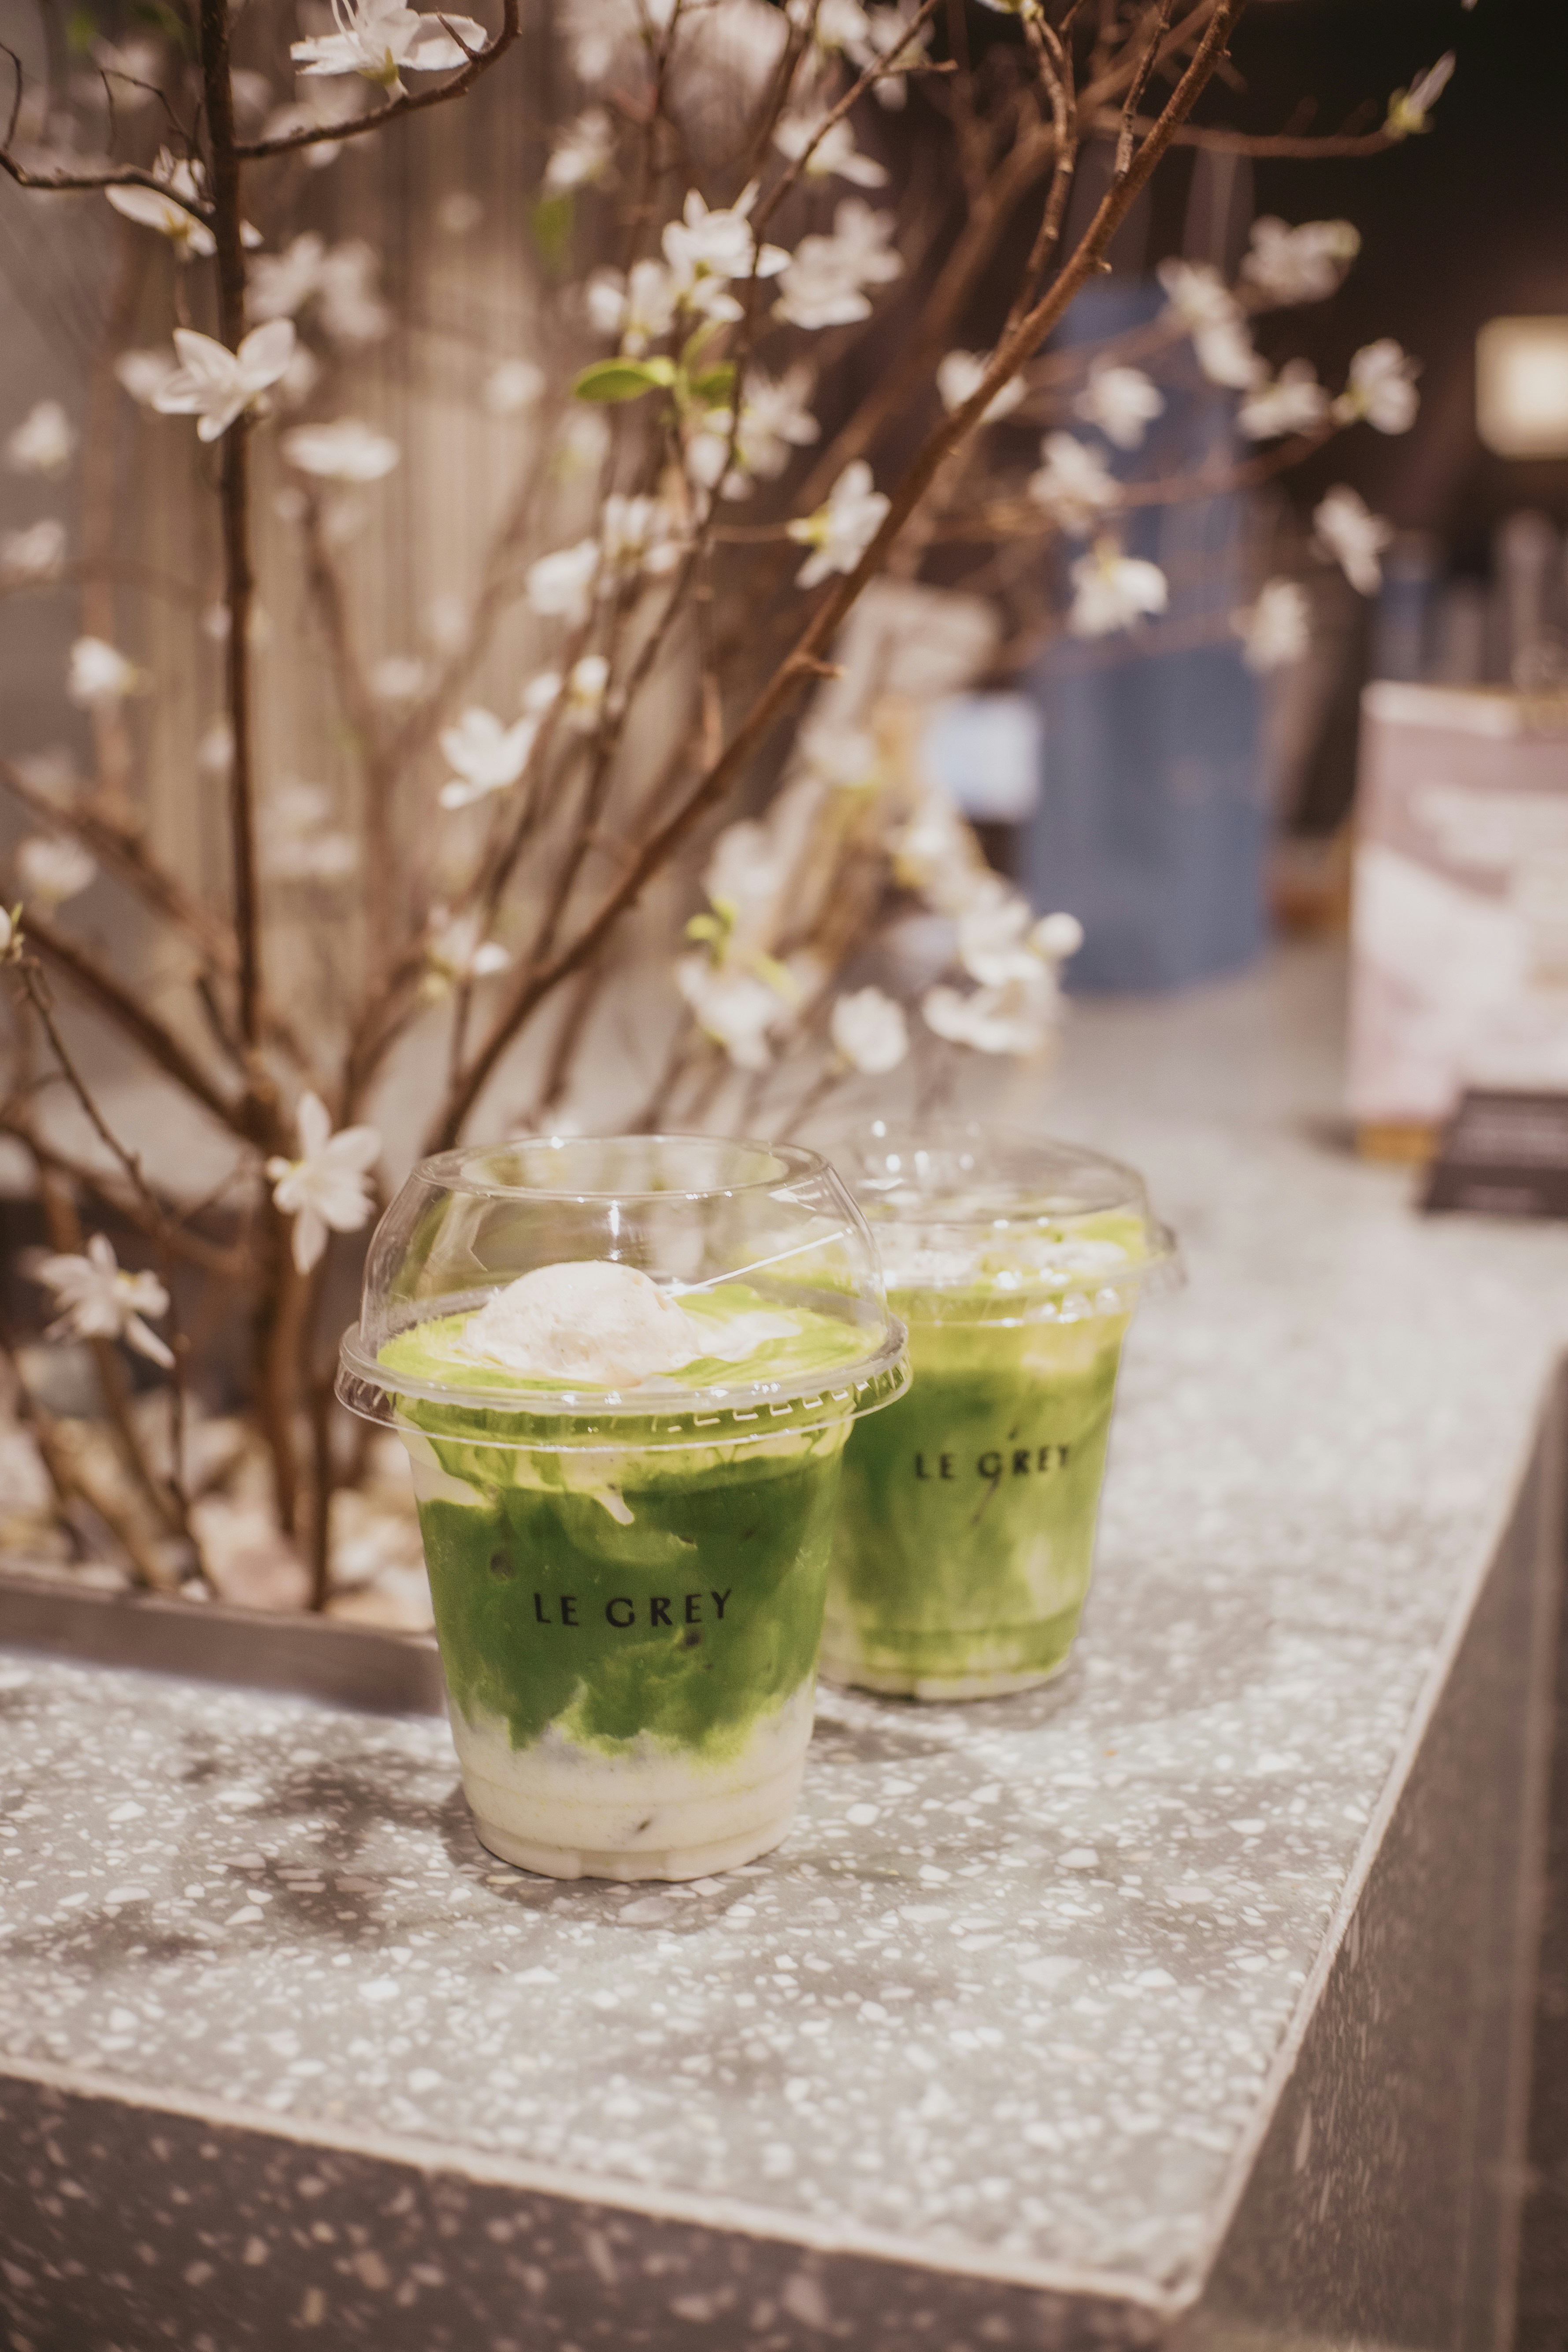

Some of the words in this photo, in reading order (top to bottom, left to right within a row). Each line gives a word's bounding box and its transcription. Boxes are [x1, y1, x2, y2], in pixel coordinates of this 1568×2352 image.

[916, 1453, 953, 1480] LE
[534, 1592, 579, 1627] LE
[605, 1588, 732, 1628] GREY
